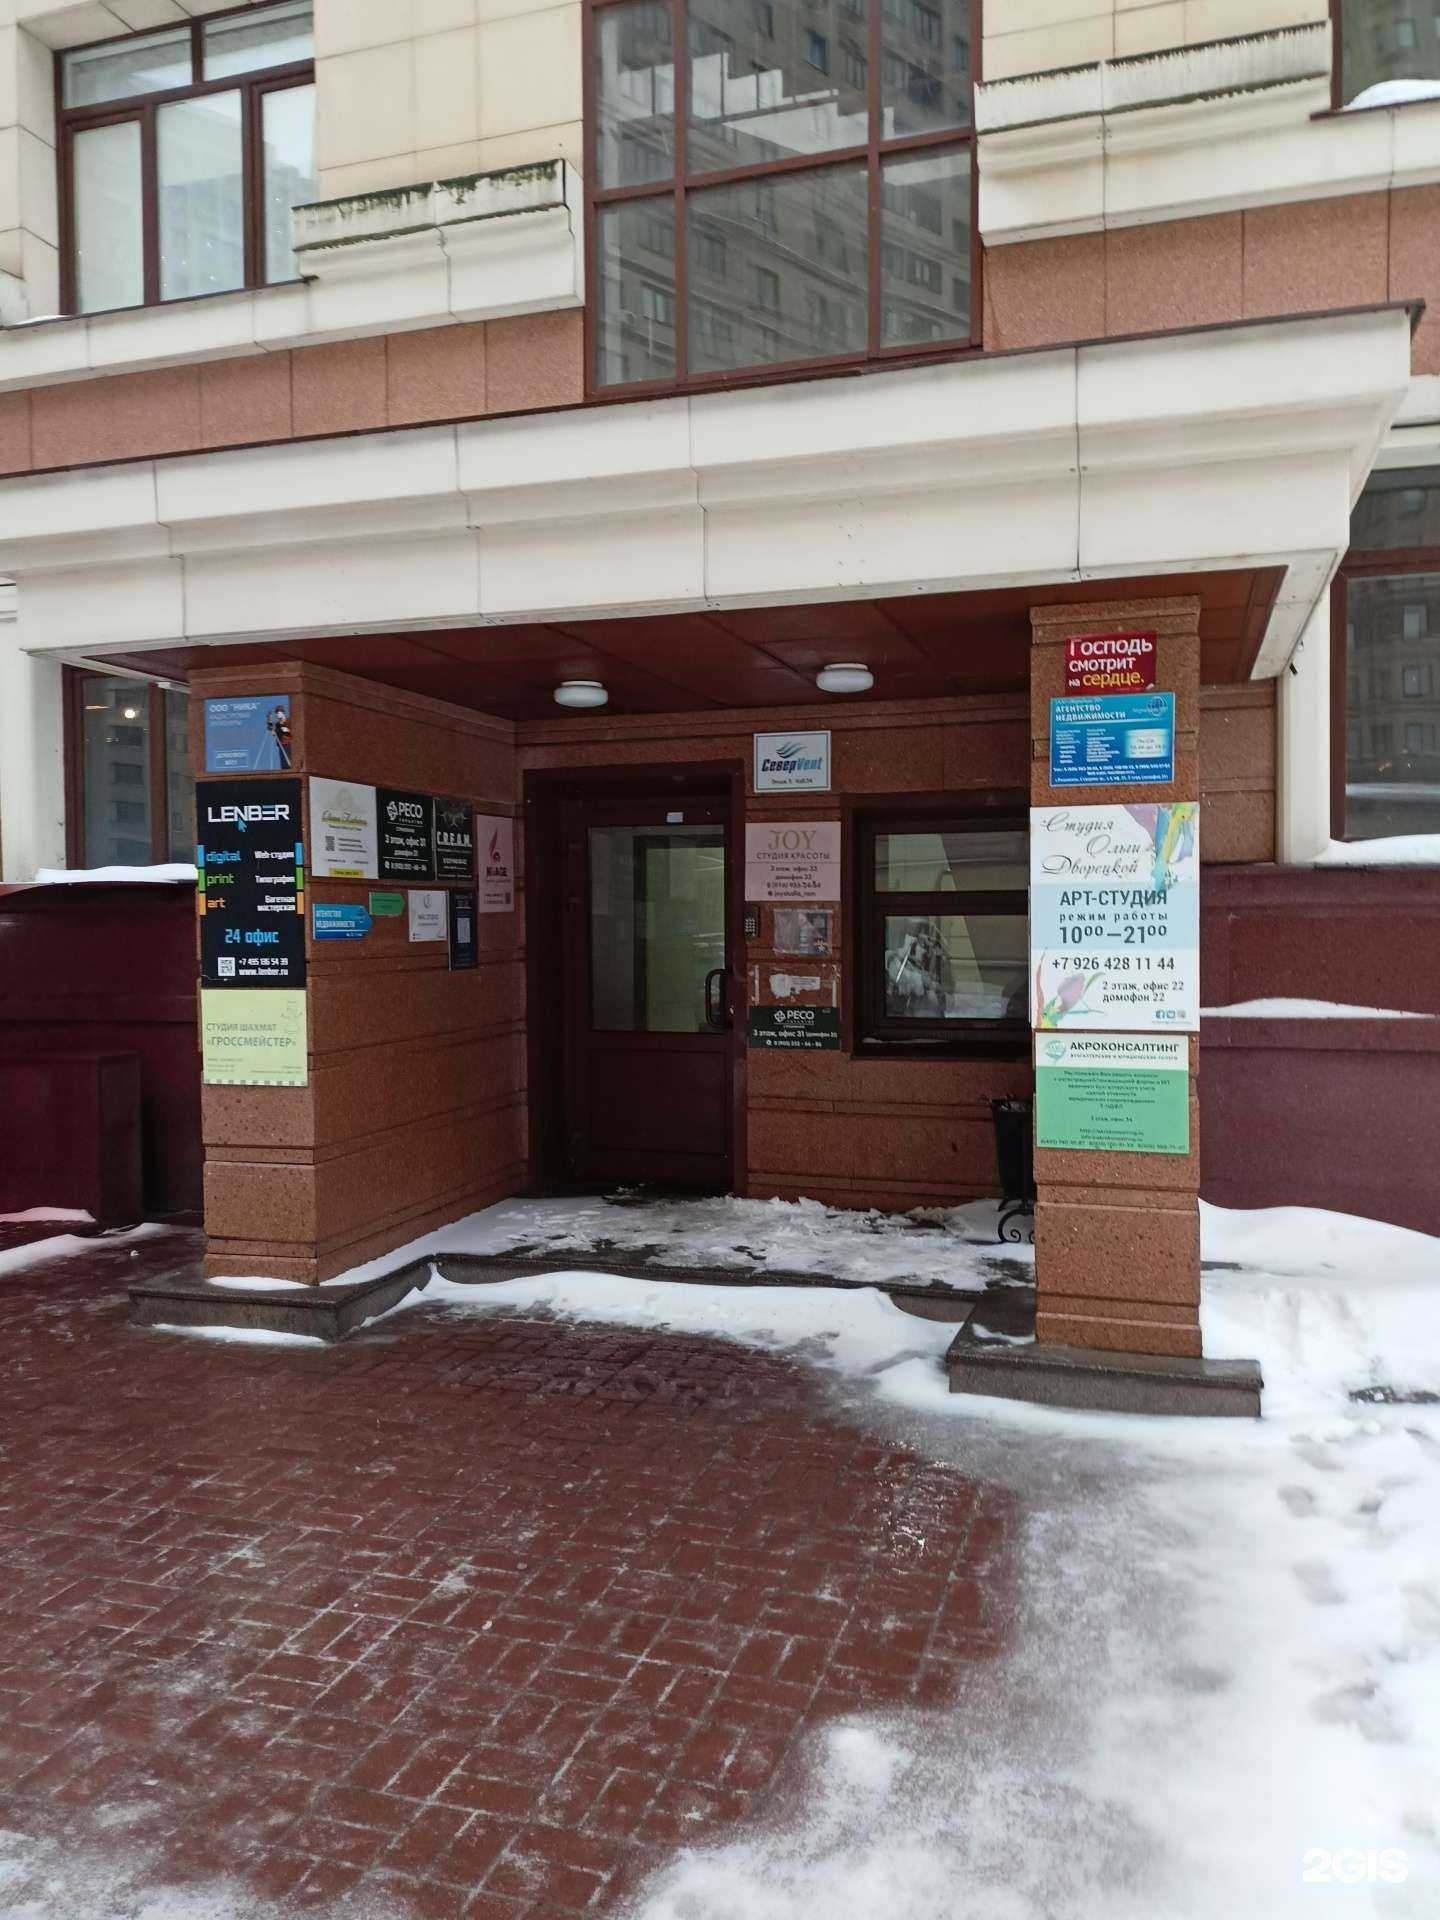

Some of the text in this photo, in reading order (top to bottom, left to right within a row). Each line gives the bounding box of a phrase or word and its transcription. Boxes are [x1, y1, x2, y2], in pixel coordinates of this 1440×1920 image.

[1069, 638, 1153, 656] Господь
[1069, 657, 1136, 674] смотрит
[1068, 671, 1145, 688] на сердце.
[1055, 704, 1101, 713] АГЕНТСТВО
[1055, 711, 1126, 722] НЕДВИЖИМОСТИ
[207, 804, 290, 823] LENBER
[1042, 811, 1114, 837] Студия
[768, 829, 817, 850] JOY
[206, 851, 241, 864] digital
[756, 852, 830, 860] СТУДИЯ КРАСОТЫ
[1041, 854, 1138, 878] Дворецкой
[207, 873, 235, 886] print
[207, 898, 226, 909] art
[1060, 890, 1168, 908] АРТ-СТУДИЯ
[1060, 911, 1168, 923] режим работы
[225, 928, 279, 947] 24 офис
[1052, 957, 1175, 970] +7 926 428 11 44
[1103, 981, 1185, 994] 2 этаж, офис 22
[1103, 992, 1166, 1003] домофон 22
[206, 1023, 277, 1032] СТУДИЯ ШАХМАТ
[206, 1036, 297, 1048] «ГРОССМЕЙСТЕР»
[1070, 1041, 1180, 1053] АКРОКОНСАЛТИНГ
